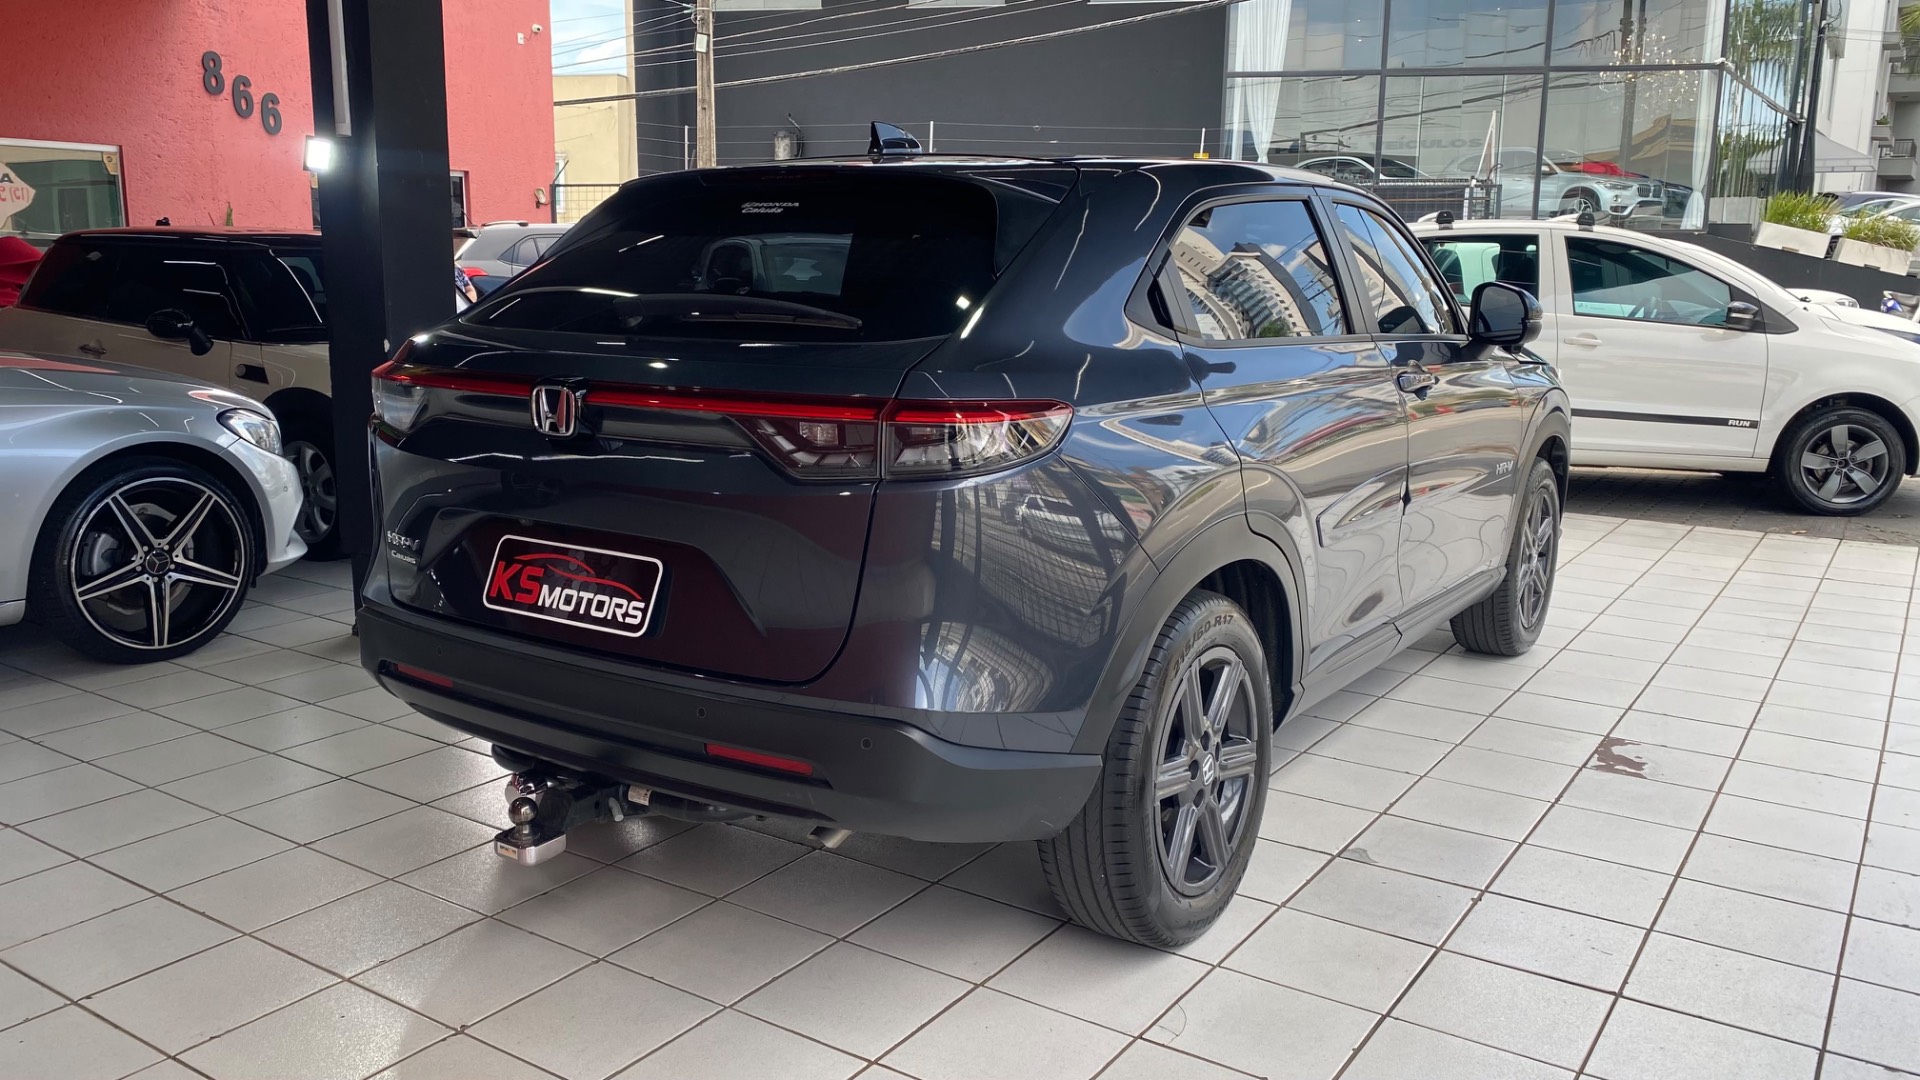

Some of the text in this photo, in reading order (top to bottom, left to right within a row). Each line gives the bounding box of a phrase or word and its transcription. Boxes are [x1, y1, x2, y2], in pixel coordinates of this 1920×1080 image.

[202, 51, 282, 136] 866
[1727, 419, 1750, 427] RUN
[489, 561, 645, 625] KS MOTORS
